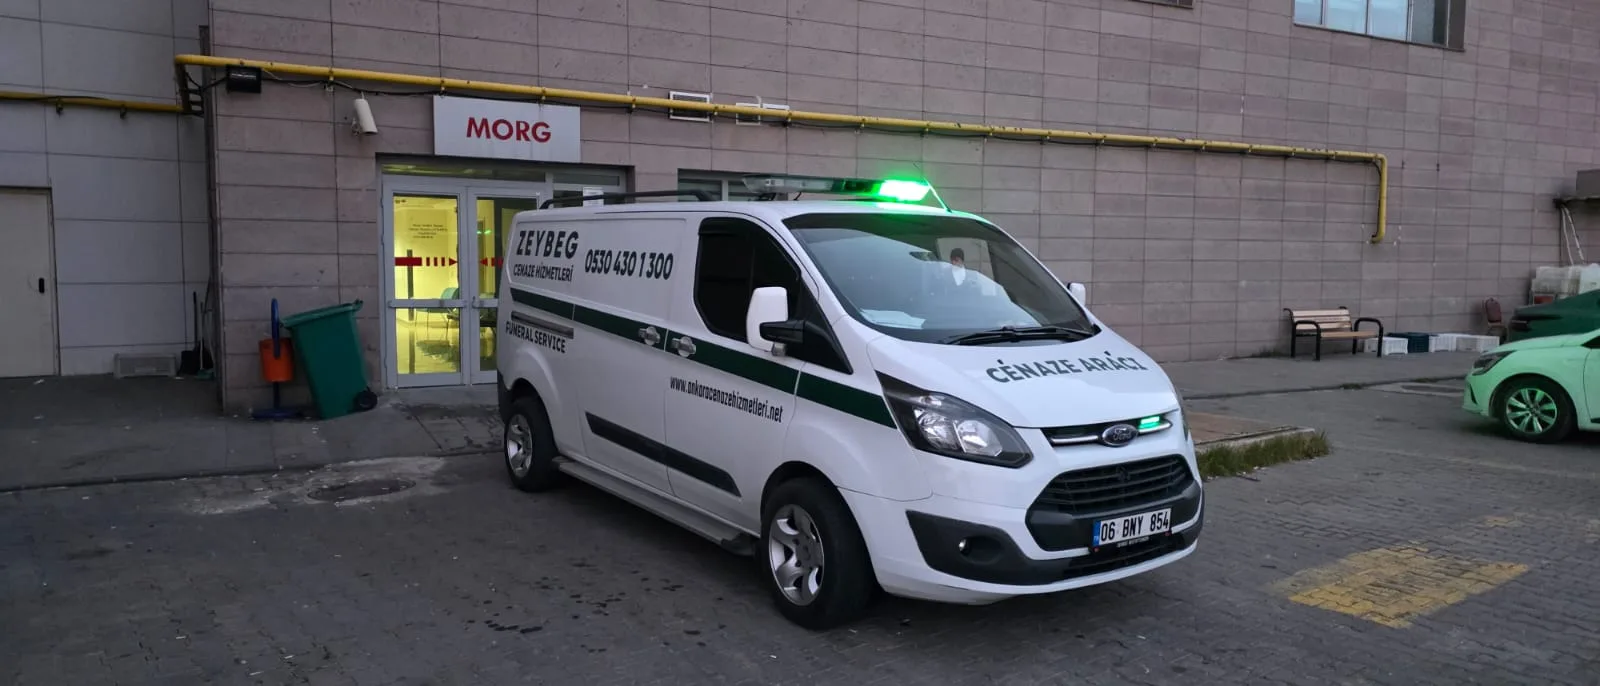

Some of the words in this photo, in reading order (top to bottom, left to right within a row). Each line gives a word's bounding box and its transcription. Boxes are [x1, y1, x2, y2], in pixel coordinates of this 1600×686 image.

[466, 117, 552, 143] MORG
[516, 230, 579, 259] ZEYBEG
[513, 264, 535, 277] CENAZE
[535, 262, 573, 282] HİZMETLERİ
[585, 249, 613, 274] 0530
[613, 250, 637, 277] 430
[505, 320, 534, 342] FUNERAL
[534, 330, 566, 354] SERVICE
[986, 359, 1083, 383] CENAZE
[1101, 521, 1116, 541] 06
[1122, 515, 1144, 538] BNY
[1149, 511, 1169, 532] 854
